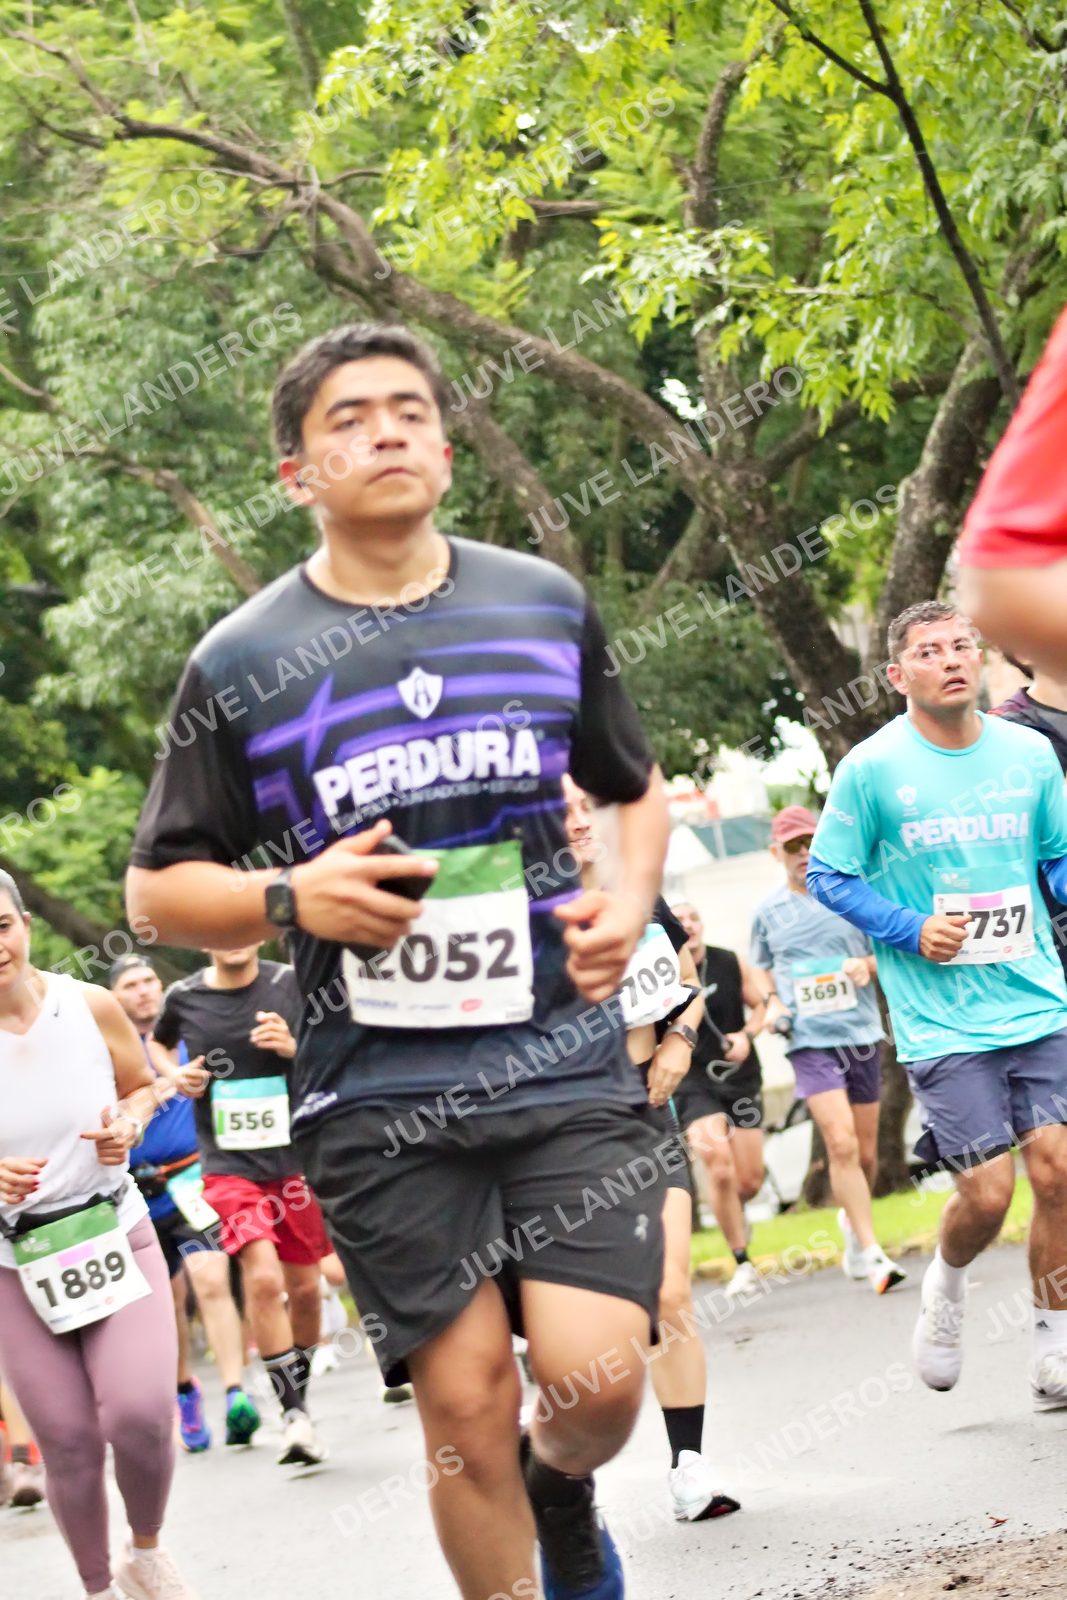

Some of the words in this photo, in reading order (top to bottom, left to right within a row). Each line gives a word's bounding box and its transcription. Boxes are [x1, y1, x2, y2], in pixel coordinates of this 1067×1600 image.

[313, 729, 541, 817] PERDURA
[945, 904, 1026, 939] 737
[801, 981, 848, 1002] 3691
[229, 1110, 275, 1131] 556
[36, 1251, 126, 1308] 1889
